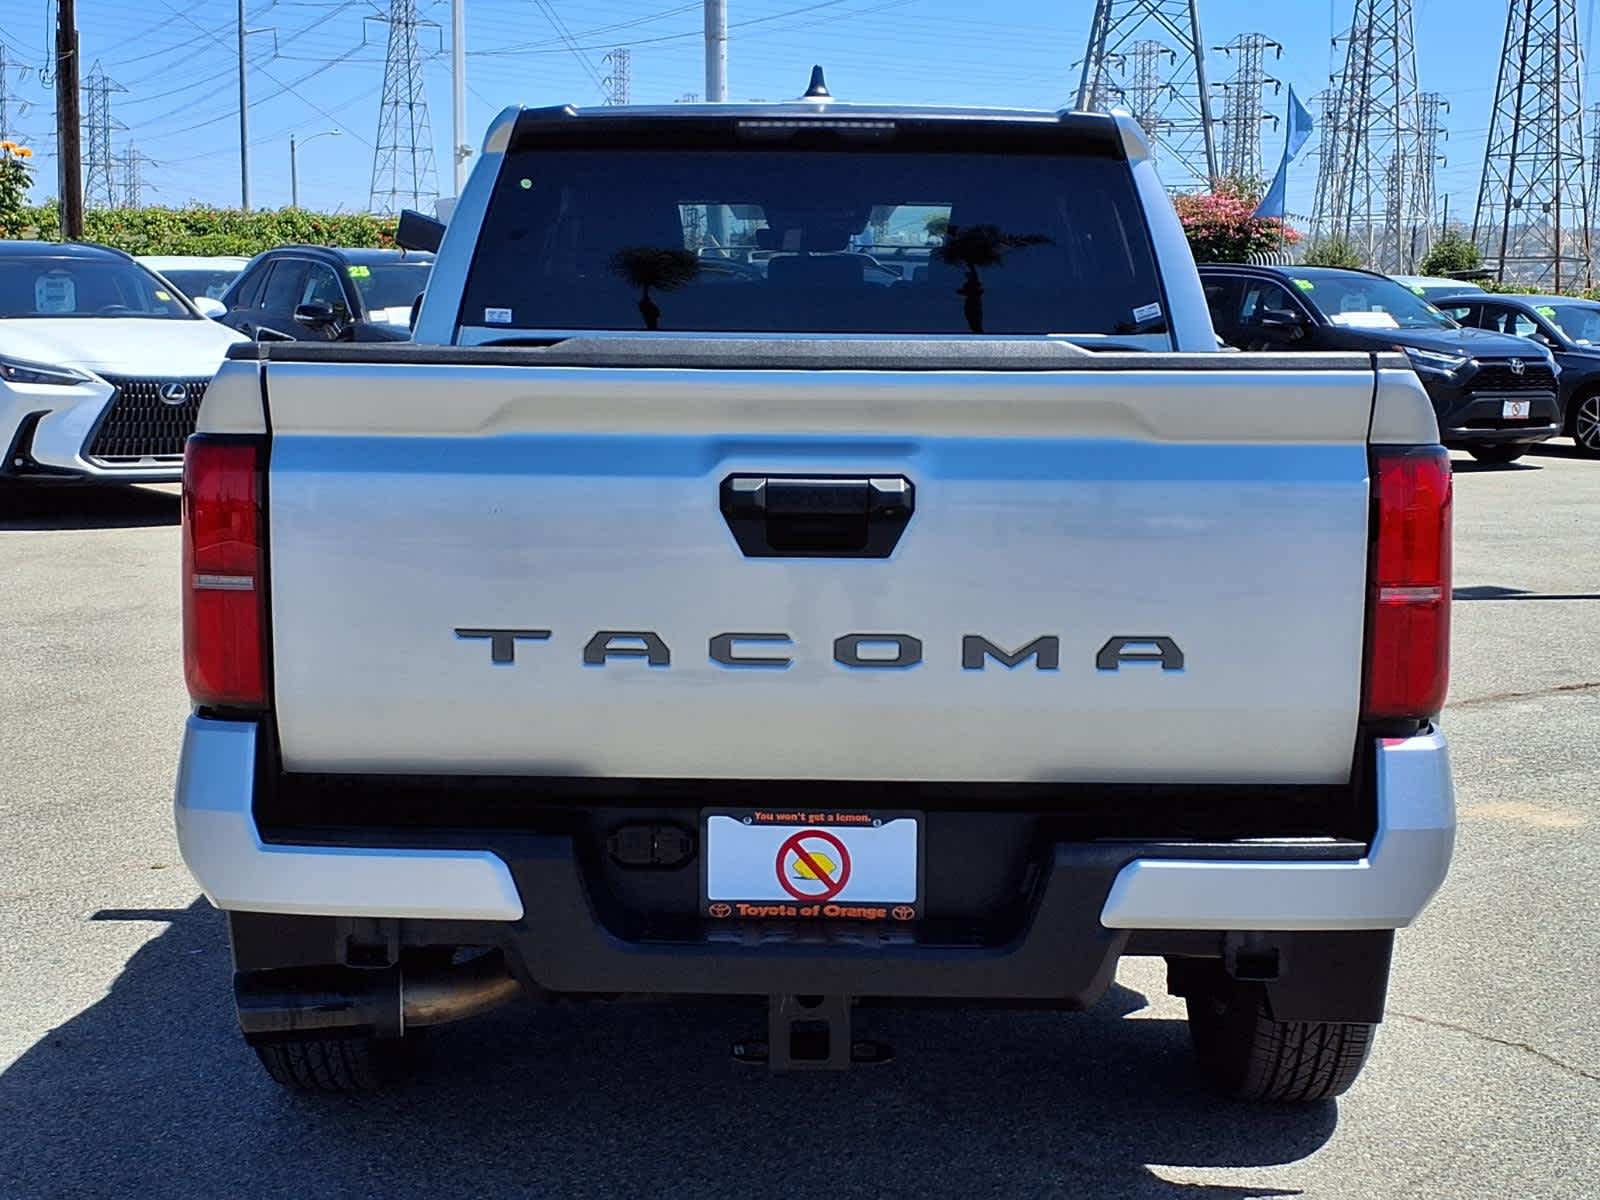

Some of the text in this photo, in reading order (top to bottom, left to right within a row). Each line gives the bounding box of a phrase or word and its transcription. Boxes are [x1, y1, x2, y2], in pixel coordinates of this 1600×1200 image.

[454, 627, 1186, 671] TACOMA
[754, 811, 872, 824] You won't get a lemon.
[735, 903, 888, 920] Toyota of Orange
